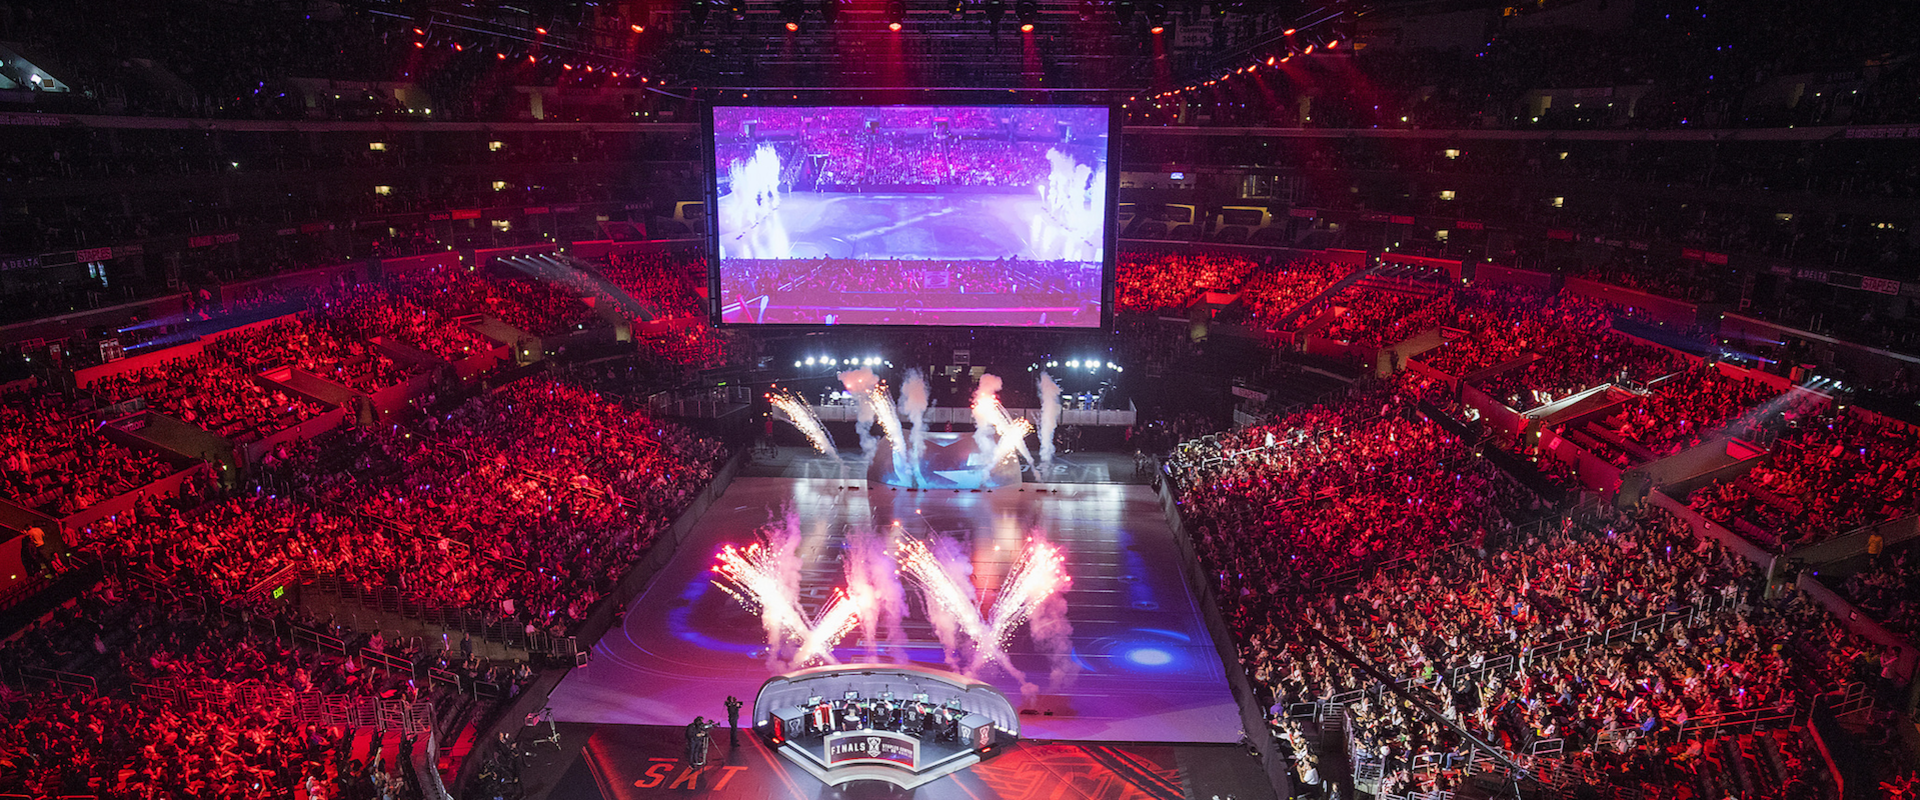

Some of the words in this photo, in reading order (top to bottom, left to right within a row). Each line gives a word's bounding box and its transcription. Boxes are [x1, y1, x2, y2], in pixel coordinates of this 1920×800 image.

[78, 248, 112, 262] STAPLES
[10, 257, 40, 269] DELTA
[1804, 270, 1828, 283] DELTA
[1862, 277, 1899, 294] STAPLES
[831, 742, 866, 756] FINALS
[633, 757, 749, 791] SKT
